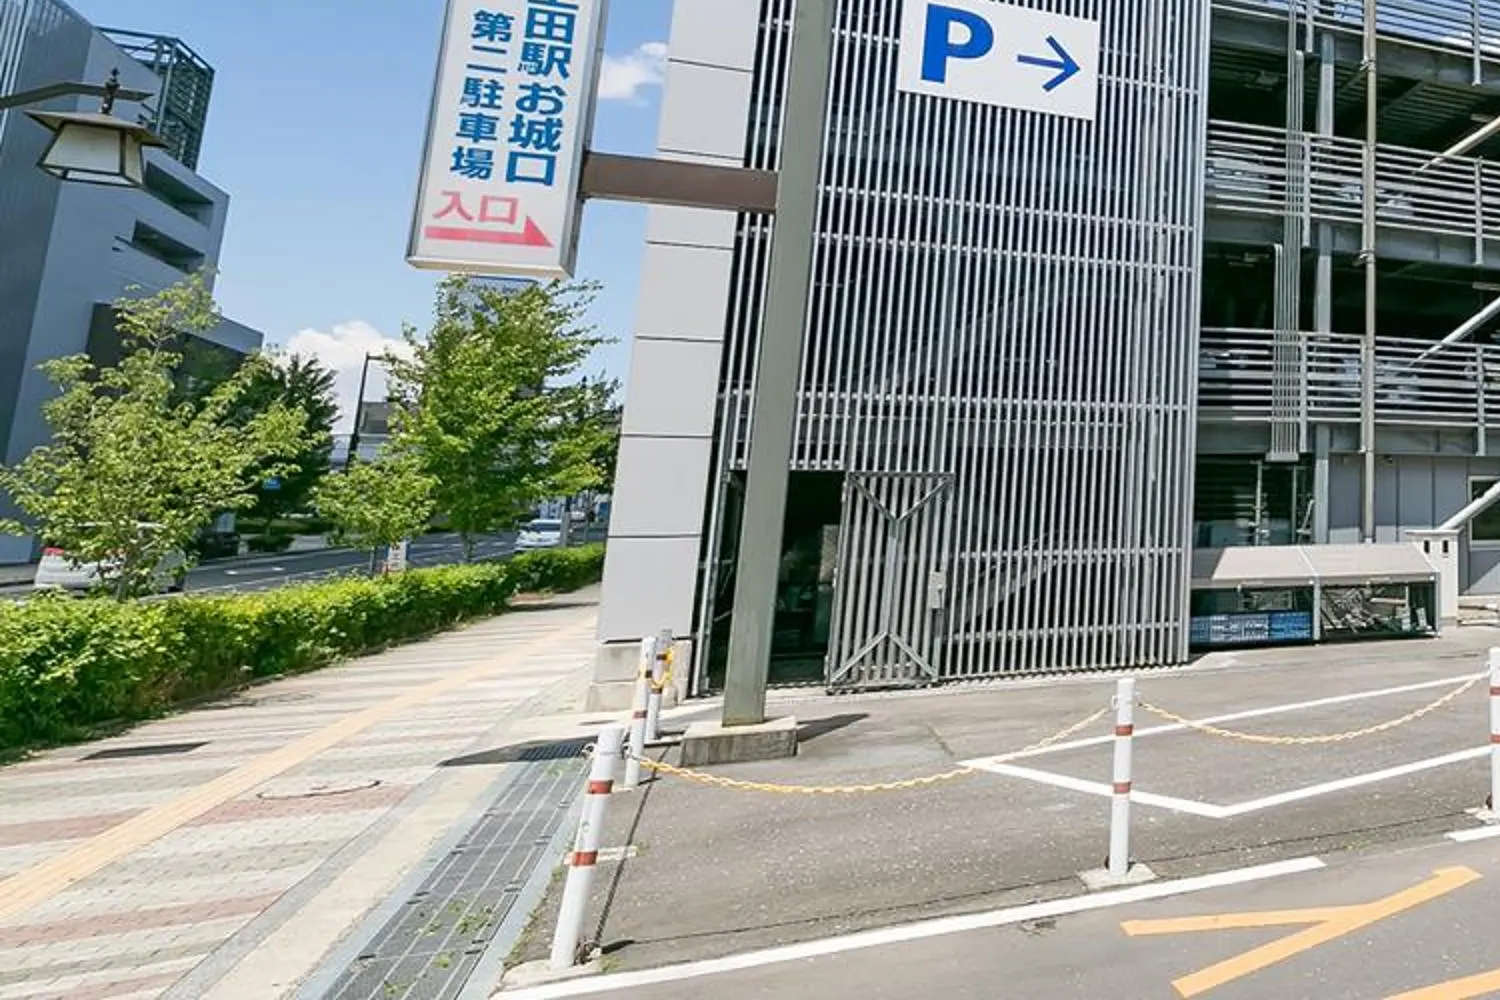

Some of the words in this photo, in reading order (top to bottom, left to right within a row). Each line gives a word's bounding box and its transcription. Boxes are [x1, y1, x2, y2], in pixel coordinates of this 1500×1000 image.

[920, 3, 994, 85] P
[449, 8, 515, 181] 第二駐車場
[432, 190, 518, 226] 入口
